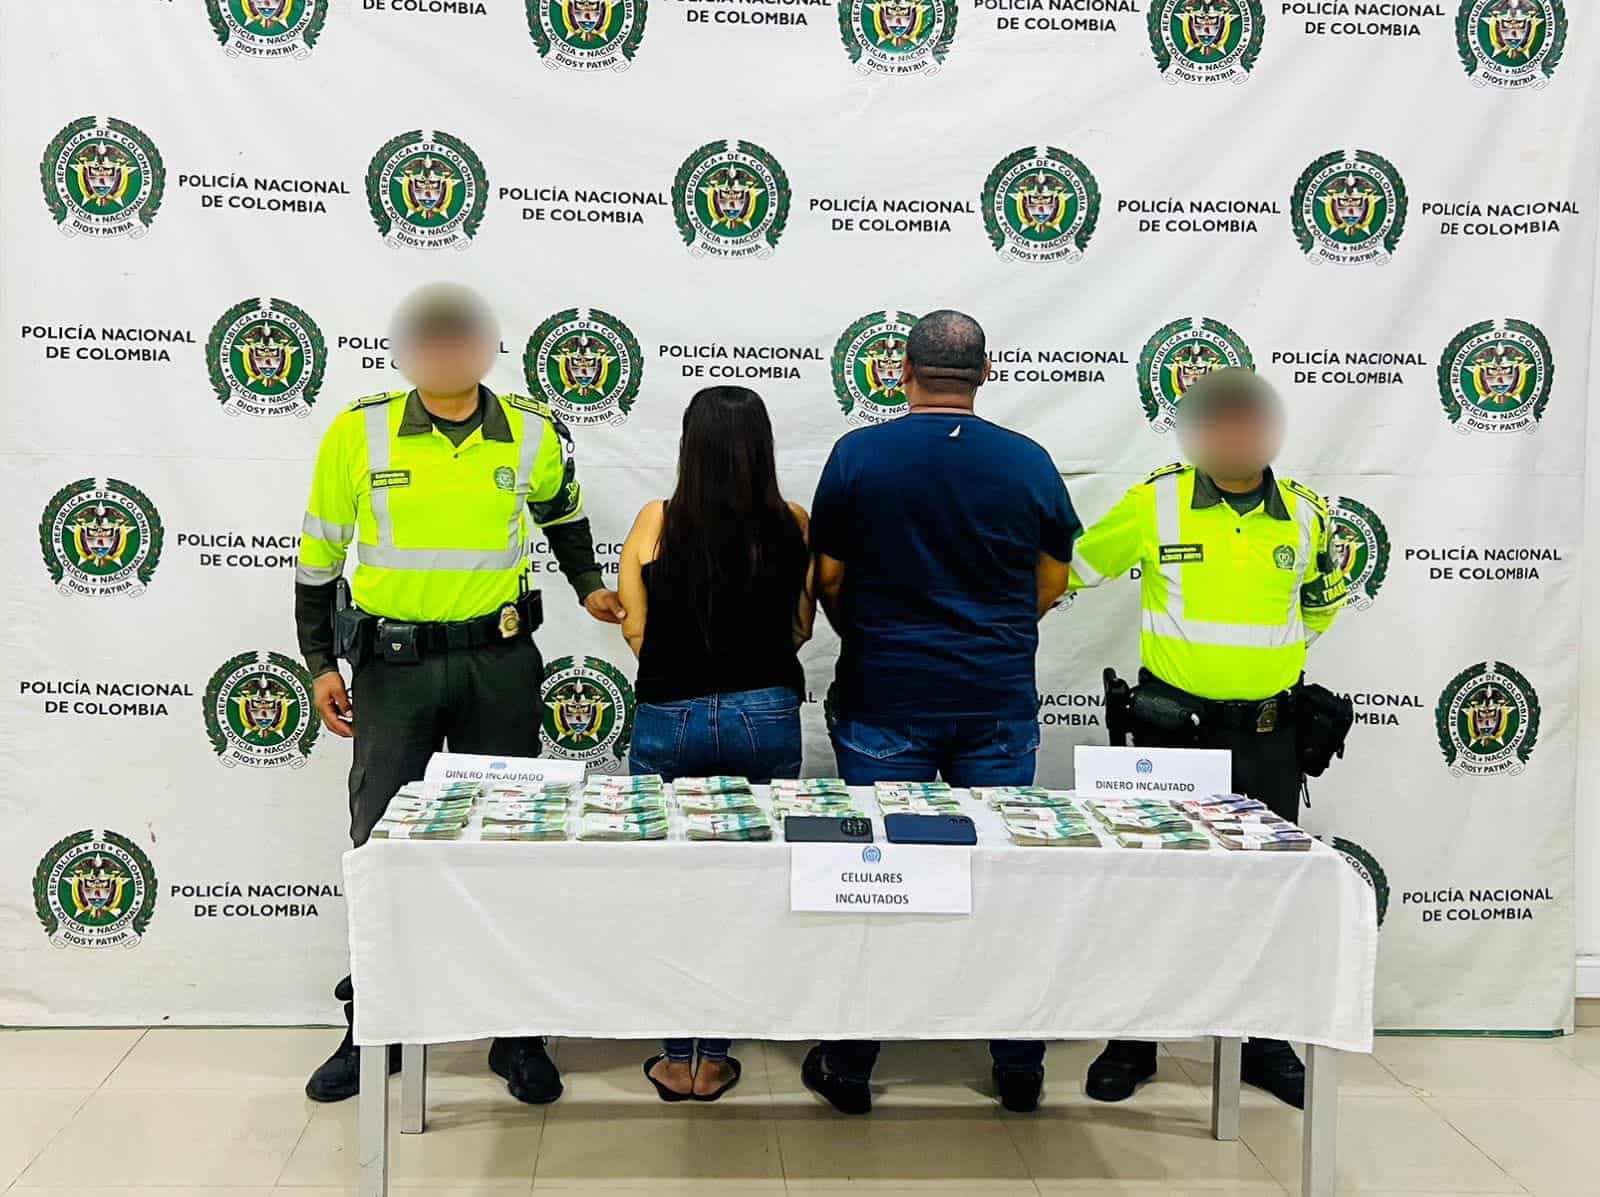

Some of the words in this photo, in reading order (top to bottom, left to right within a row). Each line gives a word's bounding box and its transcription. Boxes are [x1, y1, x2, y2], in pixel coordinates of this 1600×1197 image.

[364, 0, 385, 10] DE
[391, 0, 487, 15] COLOMBIA
[1049, 0, 1140, 12] NACIONAL
[1281, 0, 1350, 15] POLICÍA
[1354, 4, 1446, 17] NACIONAL
[686, 10, 709, 23] DE
[714, 11, 808, 25] COLOMBIA
[997, 17, 1019, 30] DE
[1024, 18, 1117, 31] COLOMBIA
[1305, 22, 1326, 34] DE
[1331, 23, 1421, 36] COLOMBIA
[178, 171, 249, 189] POLICÍA
[254, 179, 351, 194] NACIONAL
[499, 185, 570, 202] POLICÍA
[574, 191, 668, 205] NACIONAL
[201, 195, 223, 208] DE
[228, 196, 327, 214] COLOMBIA
[809, 195, 878, 212] POLICÍA
[883, 200, 975, 214] NACIONAL
[1117, 197, 1185, 213] POLICÍA
[1189, 201, 1281, 214] NACIONAL
[1422, 200, 1482, 217] POLICÍA
[1487, 201, 1580, 217] NACIONAL
[522, 208, 545, 220] DE
[550, 209, 644, 224] COLOMBIA
[831, 218, 854, 231] DE
[858, 219, 951, 232] COLOMBIA
[1139, 219, 1161, 232] DE
[1165, 219, 1258, 233] COLOMBIA
[1440, 222, 1459, 235] DE
[1463, 220, 1560, 236] COLOMBIA
[21, 323, 97, 341] POLICÍA
[101, 328, 196, 343] NACIONAL
[338, 336, 392, 350] POLIC
[46, 346, 70, 360] DE
[76, 347, 171, 362] COLOMBIA
[659, 343, 729, 359] POLICÍA
[733, 346, 825, 360] NACIONAL
[986, 348, 1033, 363] LICÍA
[1038, 351, 1129, 364] NACIONAL
[1272, 349, 1341, 365] POLICÍA
[1345, 352, 1427, 366] NACIONAL
[362, 356, 385, 369] DE
[682, 365, 705, 377] DE
[709, 365, 801, 379] COLOMBIA
[988, 370, 1009, 382] DE
[1014, 370, 1105, 383] COLOMBIA
[1294, 371, 1317, 384] DE
[1321, 371, 1403, 384] COLOMBIA
[177, 531, 246, 548] POLICÍA
[251, 535, 302, 549] NACI
[1405, 545, 1479, 561] POLICÍA
[1484, 548, 1562, 561] NACIONAL
[200, 554, 222, 567] DE
[226, 554, 299, 568] COLOM
[1430, 567, 1453, 580] DE
[1458, 567, 1540, 580] COLOMBIA
[20, 678, 91, 695] POLICÍA
[96, 683, 194, 697] NACIONAL
[45, 700, 69, 714] DE
[73, 701, 169, 716] COLOMBIA
[1354, 712, 1400, 726] MBIA
[445, 769, 483, 779] DINERO
[1095, 780, 1133, 790] DINERO
[1136, 781, 1196, 792] INCAUTADO
[841, 872, 903, 884] CELULARES
[171, 882, 243, 898] POLICÍA
[247, 884, 344, 897] NACIONAL
[1402, 887, 1465, 905] POLICÍA
[1469, 887, 1553, 902] NACIONAL
[835, 892, 909, 905] INCAUTADOS
[194, 904, 217, 917] DE
[222, 903, 319, 917] COLOMBIA
[1422, 909, 1442, 922] DE
[1446, 907, 1533, 921] COLOMBIA
